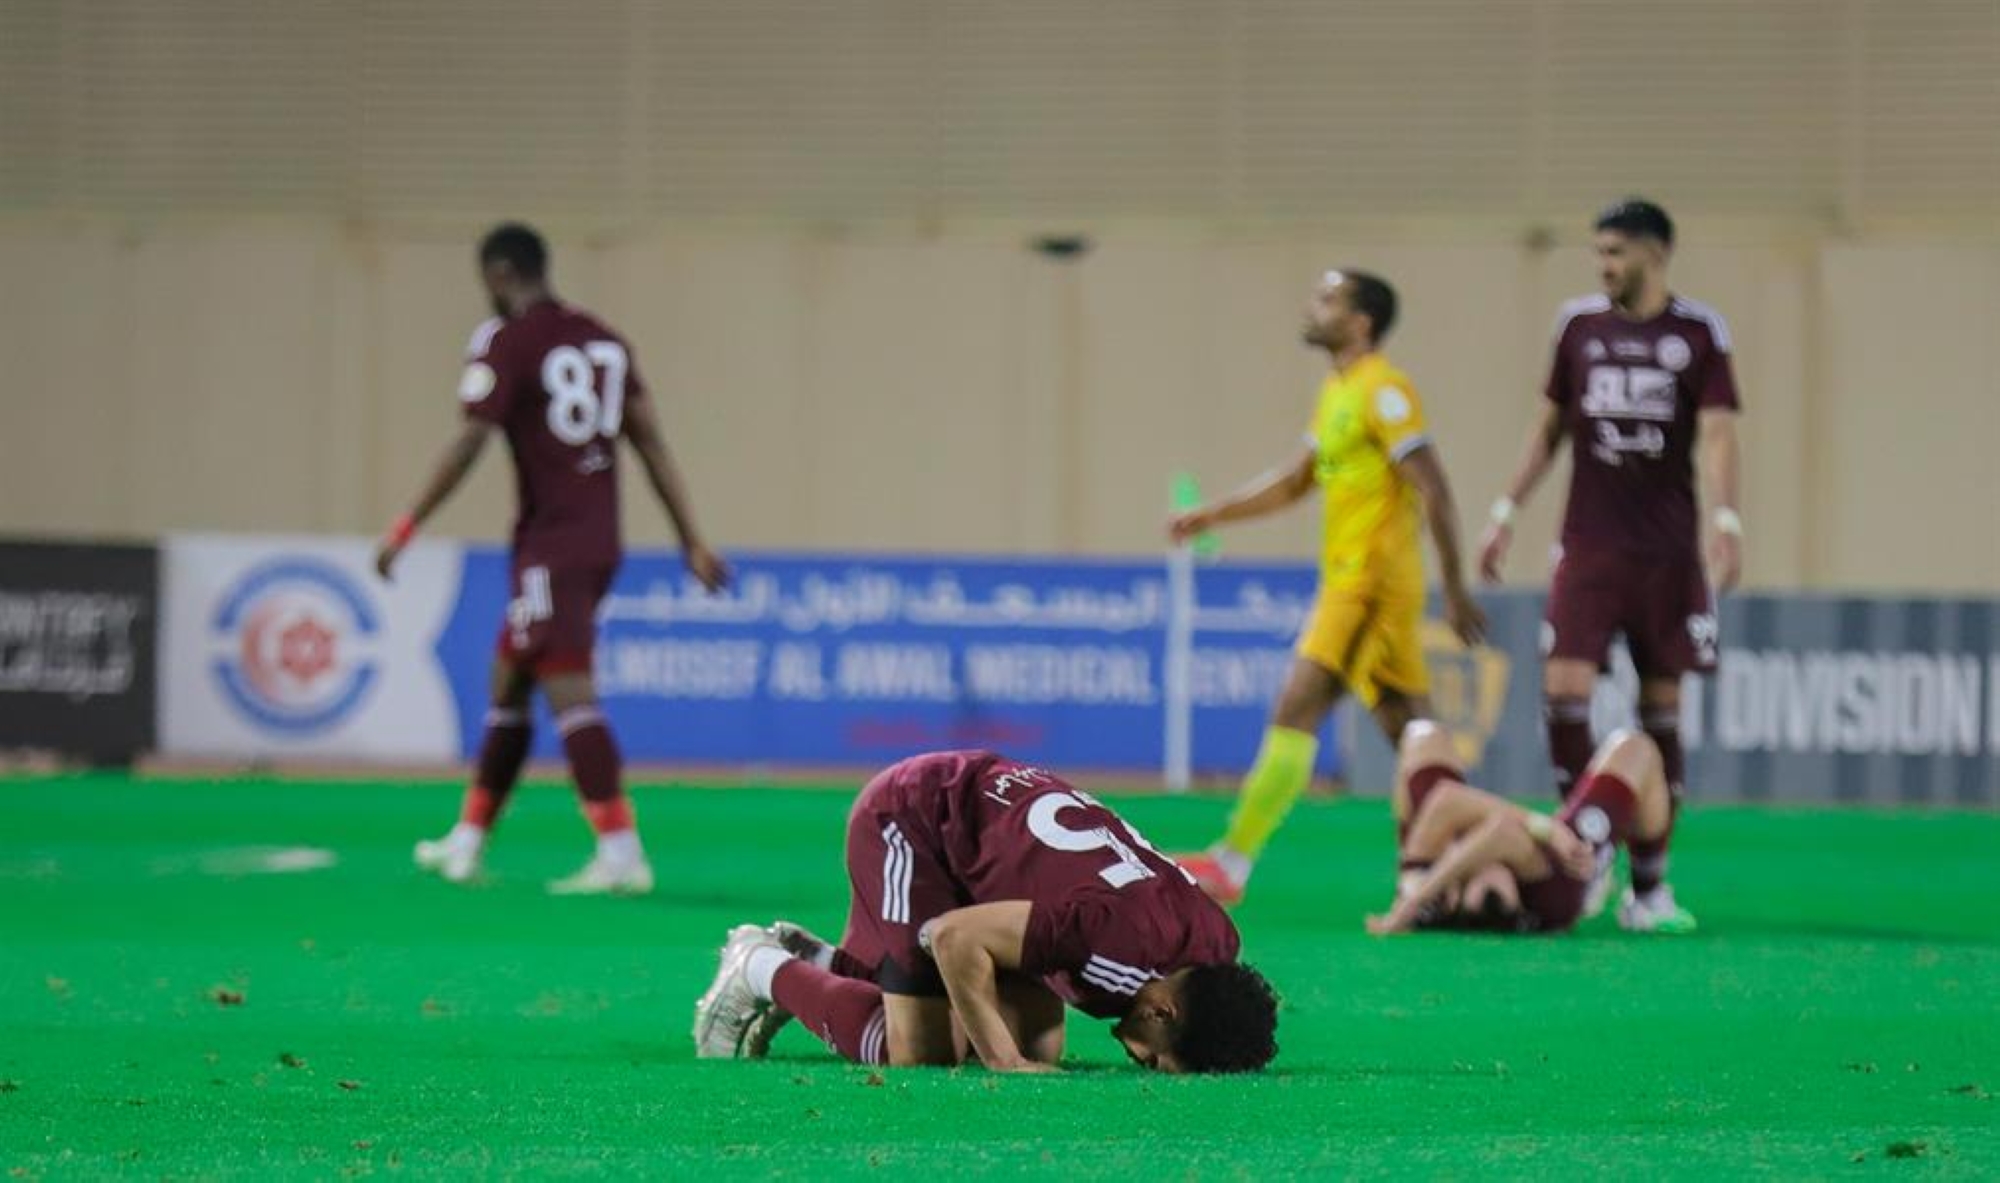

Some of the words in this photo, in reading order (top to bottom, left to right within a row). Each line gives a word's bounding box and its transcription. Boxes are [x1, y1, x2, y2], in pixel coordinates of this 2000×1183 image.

[541, 340, 629, 446] 87
[963, 642, 1160, 707] MEDICAL
[1717, 648, 1982, 756] DIVISION
